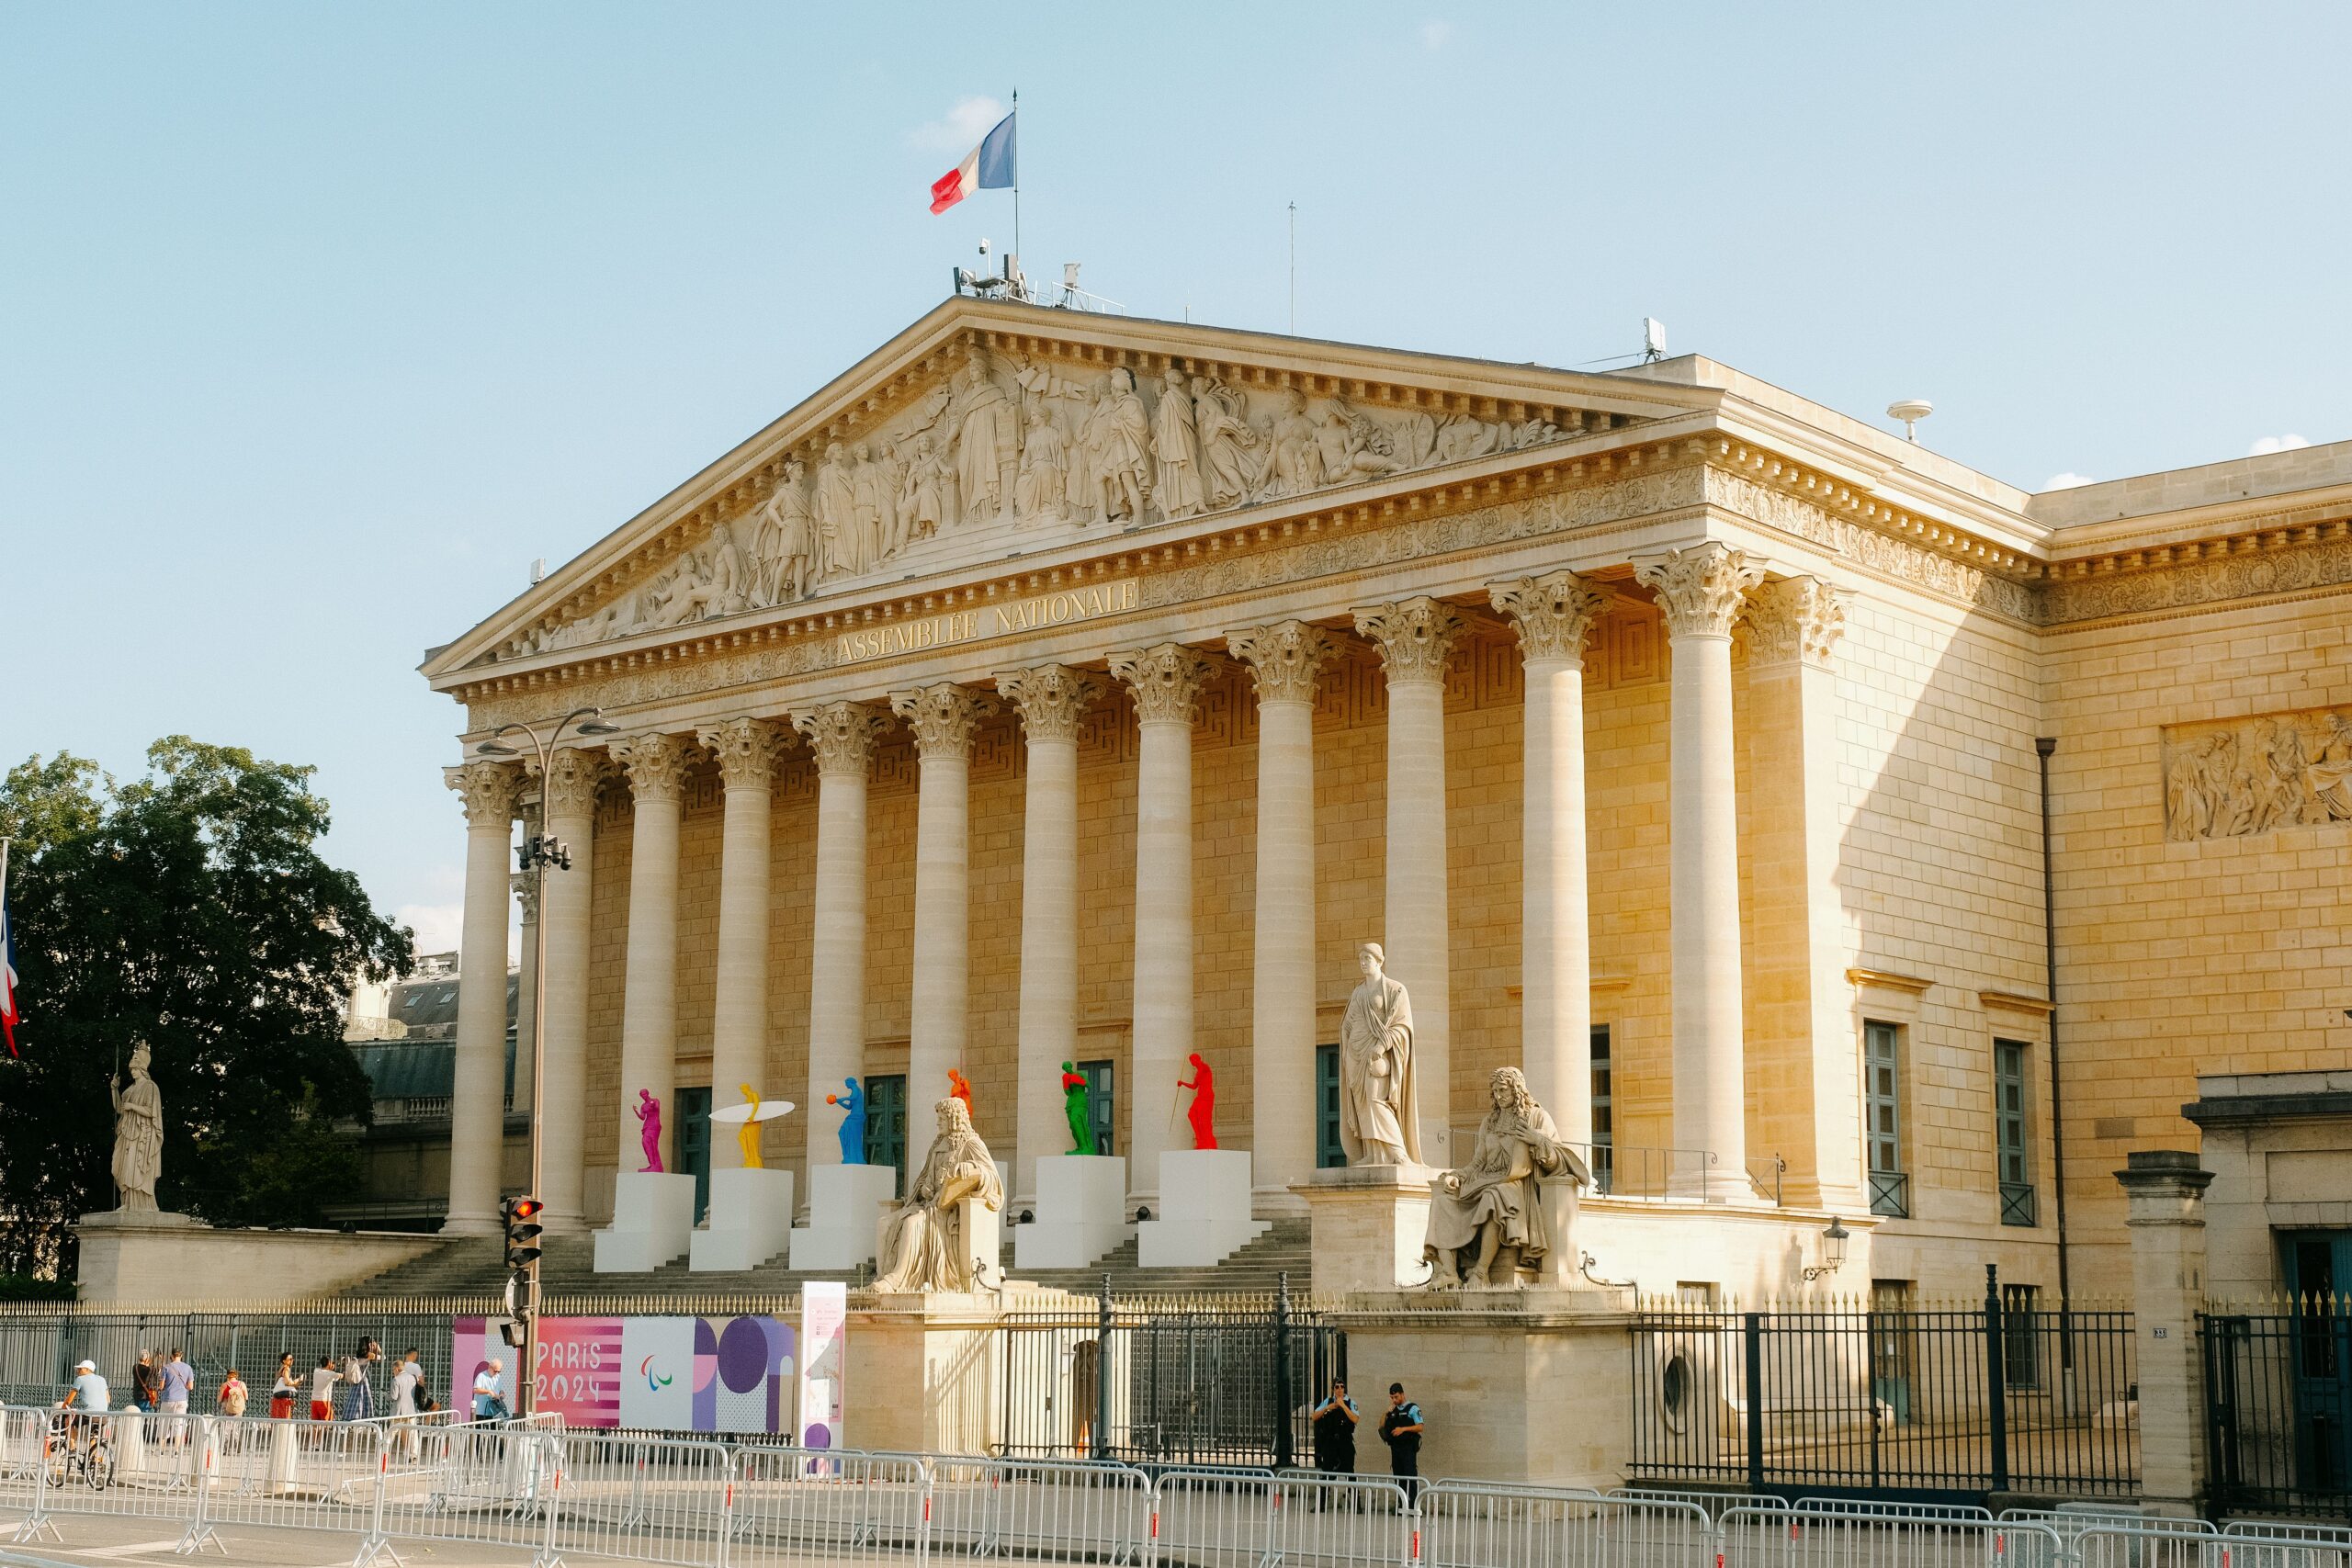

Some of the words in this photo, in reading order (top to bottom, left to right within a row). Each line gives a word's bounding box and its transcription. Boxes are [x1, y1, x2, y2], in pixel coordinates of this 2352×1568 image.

[837, 613, 978, 663] ASSEMBLÉE
[995, 581, 1136, 634] NATIONALE
[537, 1374, 600, 1402] 2024
